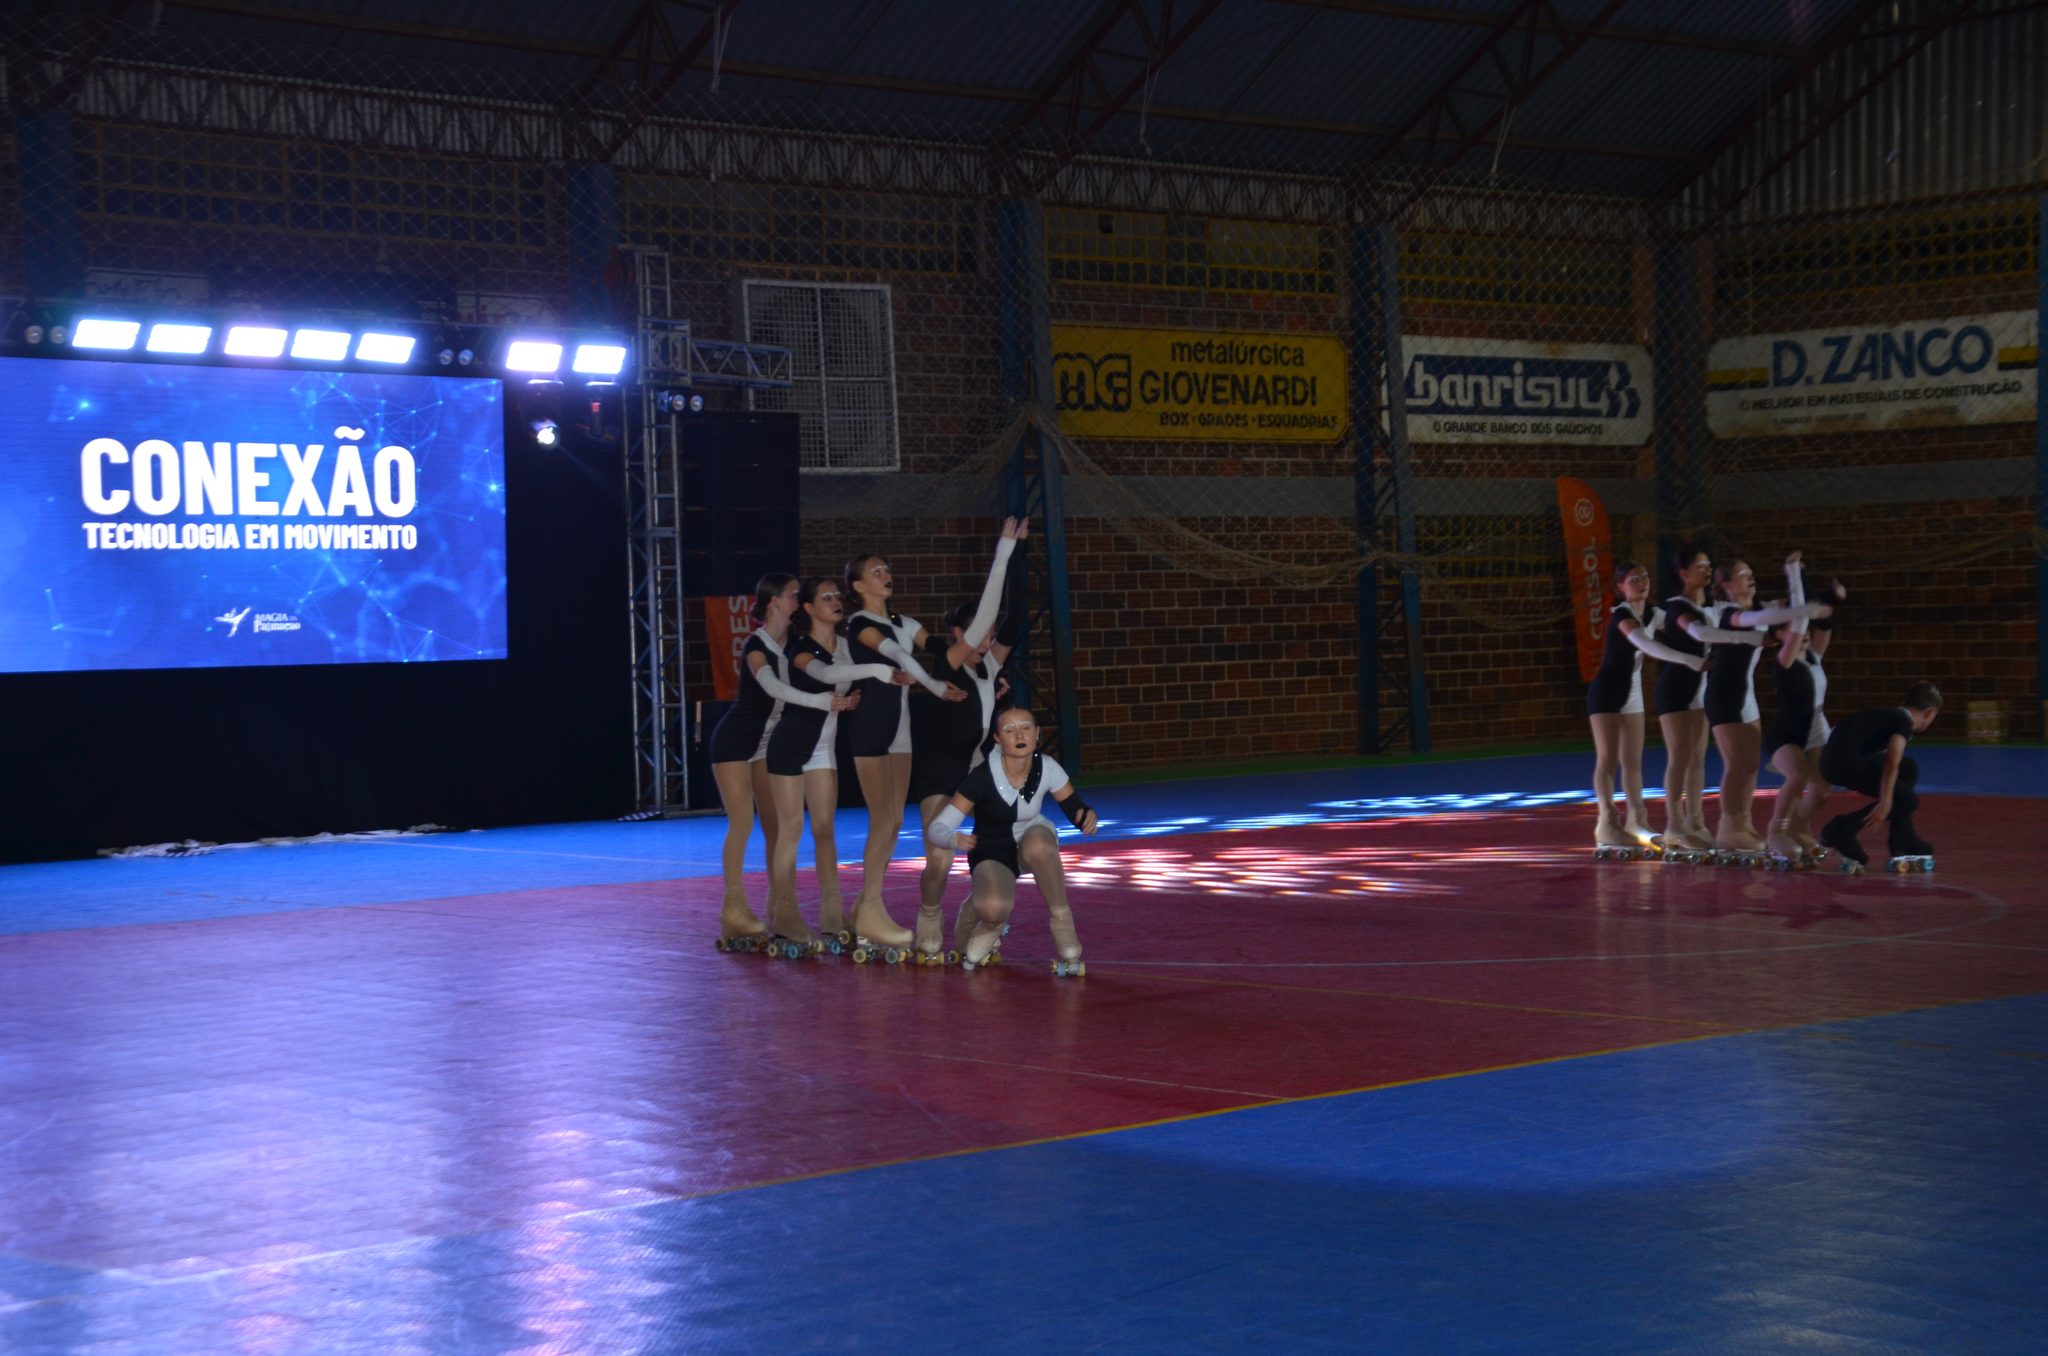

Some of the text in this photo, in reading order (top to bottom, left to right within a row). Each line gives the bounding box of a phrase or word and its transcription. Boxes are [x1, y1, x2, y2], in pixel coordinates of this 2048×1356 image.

[1171, 339, 1305, 367] metalúrgica
[1139, 370, 1318, 407] GIOVENARDI
[1405, 360, 1606, 410] banrisul
[1752, 396, 1804, 409] MELHOR
[1806, 395, 1825, 407] EM
[1829, 389, 1900, 405] MATERIAIS
[1903, 388, 1921, 400] DE
[1924, 379, 2022, 398] CONSTRUÇÃO
[1159, 412, 1338, 429] BOX GRADES ESQUADRIAS
[1433, 421, 1441, 432] O
[1444, 422, 1487, 433] GRANDE
[1490, 422, 1527, 434] BANCO
[1531, 422, 1551, 434] DOS
[81, 426, 416, 518] CONEXÃO
[82, 522, 417, 550] TECNOLOGIA EM MOVIMENTO
[1583, 536, 1603, 640] CRESOL
